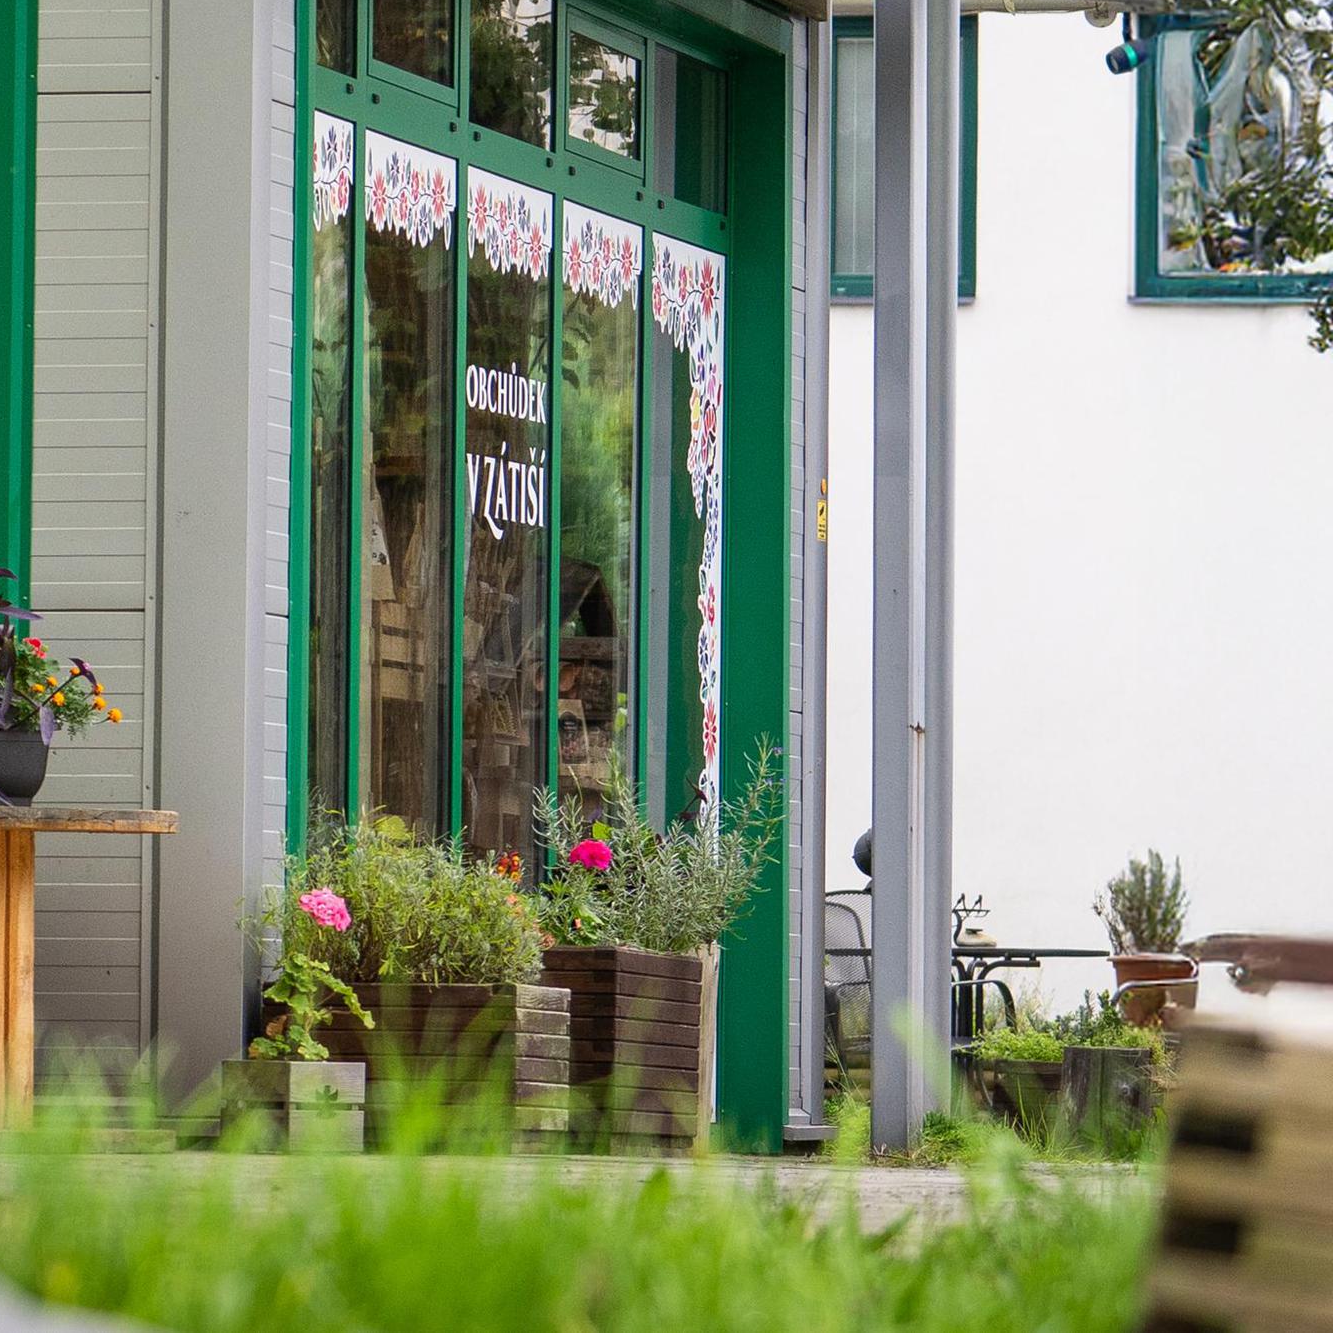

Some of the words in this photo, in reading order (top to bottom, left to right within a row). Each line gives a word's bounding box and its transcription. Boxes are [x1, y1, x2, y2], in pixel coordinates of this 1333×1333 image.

[466, 362, 547, 425] OBCHŮDEK
[466, 453, 480, 516] V
[483, 441, 547, 541] ZÁTIŠÍ
